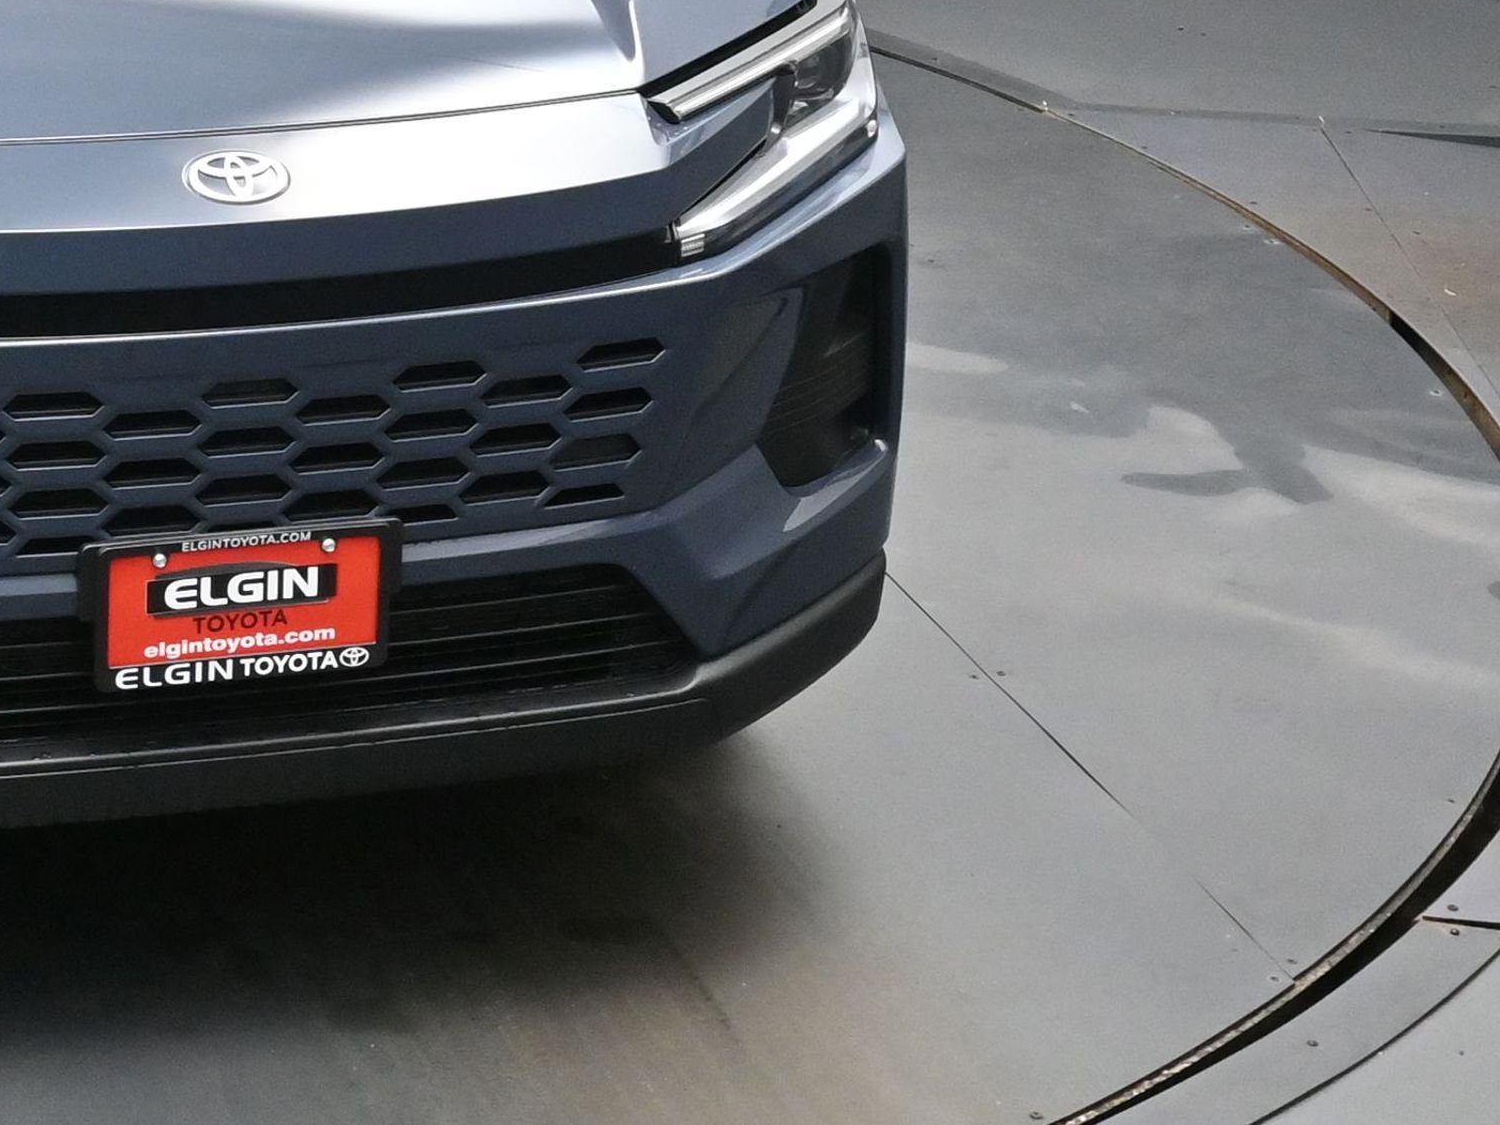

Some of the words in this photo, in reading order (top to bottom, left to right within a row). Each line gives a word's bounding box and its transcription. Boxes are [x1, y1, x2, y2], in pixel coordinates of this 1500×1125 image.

[182, 531, 312, 553] ELGINTOYOTA.COM
[164, 566, 319, 610] ELGIN
[193, 609, 288, 634] TOYOTA
[144, 628, 336, 659] elgintoyota.com
[115, 659, 234, 690] ELGIN
[240, 651, 338, 677] TOYOTA
